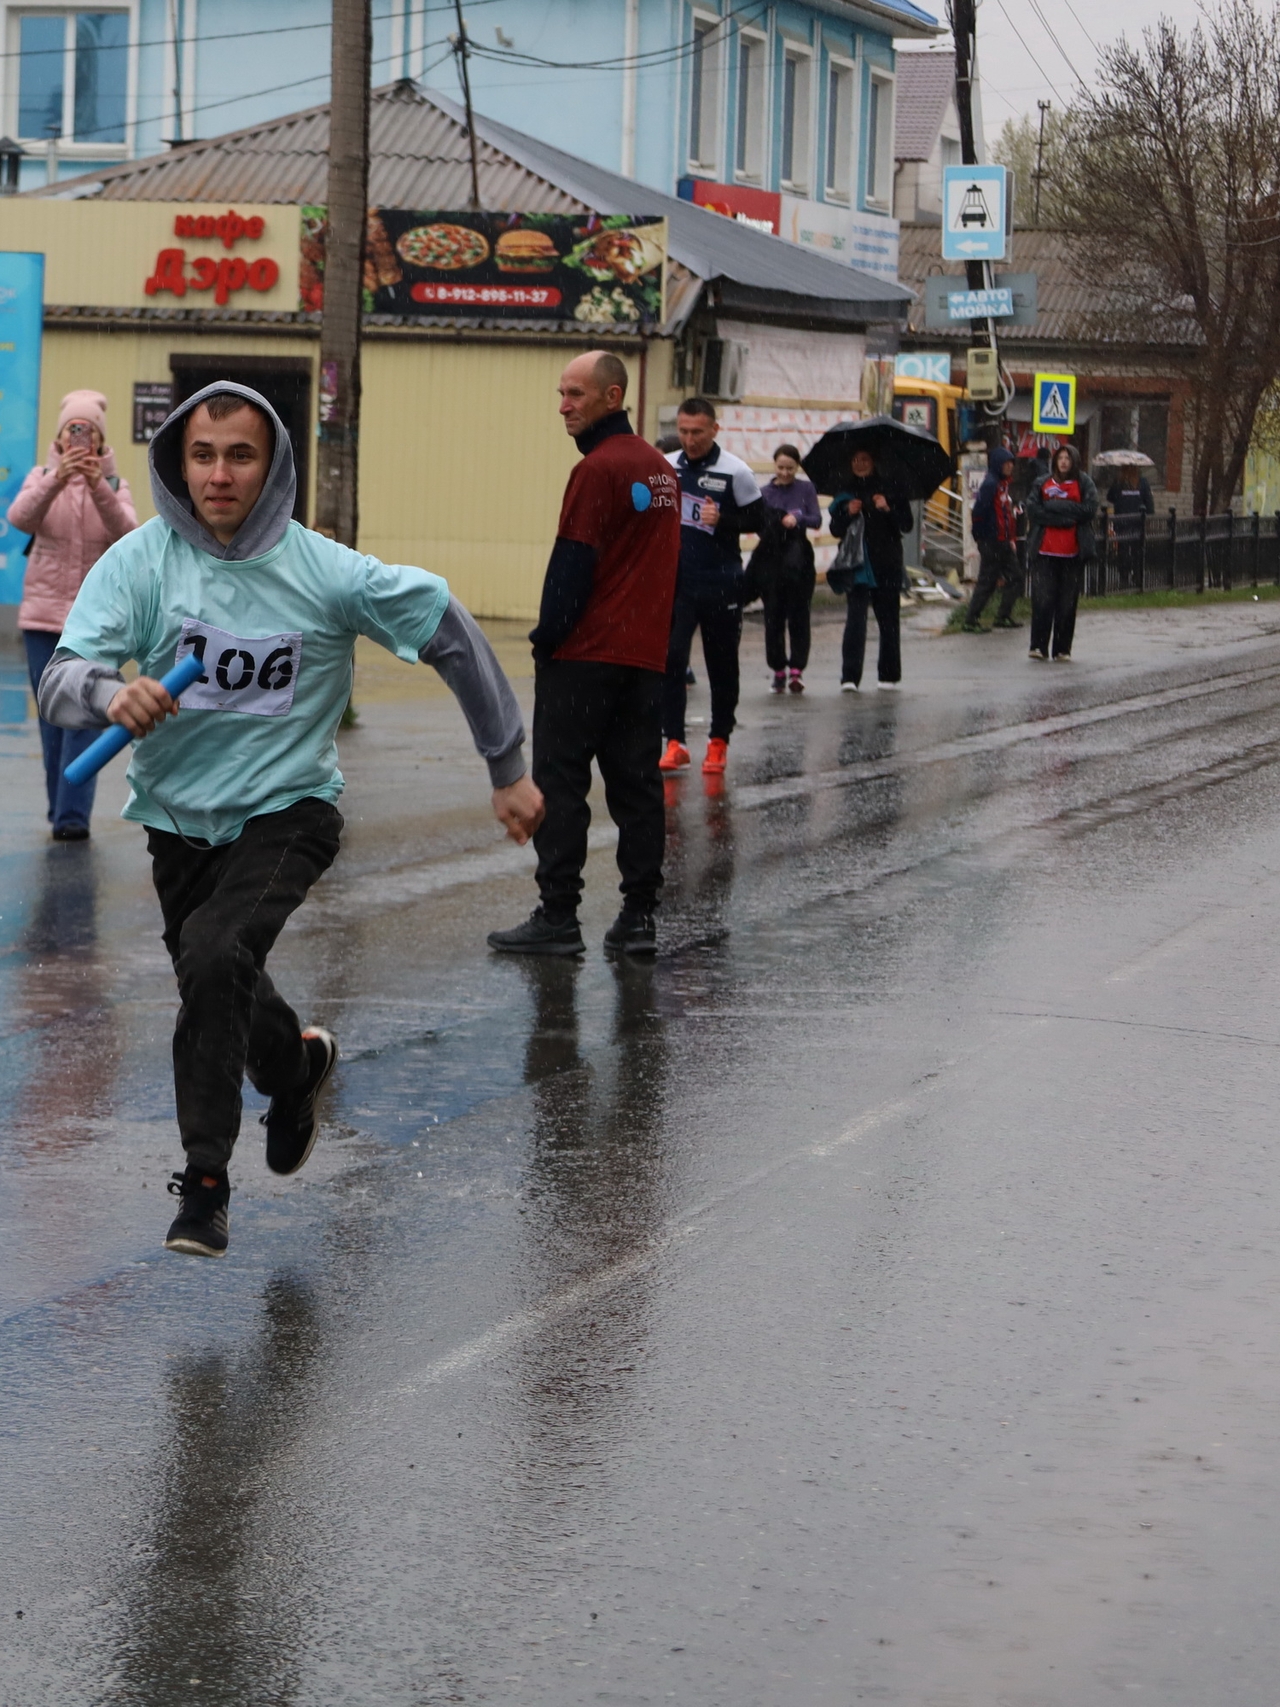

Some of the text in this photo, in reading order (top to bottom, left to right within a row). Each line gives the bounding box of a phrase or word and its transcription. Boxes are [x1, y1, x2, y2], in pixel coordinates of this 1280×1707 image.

[174, 209, 265, 249] кафе
[145, 248, 279, 306] Дэро
[967, 288, 1008, 303] АВТО
[950, 302, 1010, 319] МОЙКА
[183, 635, 293, 691] 106
